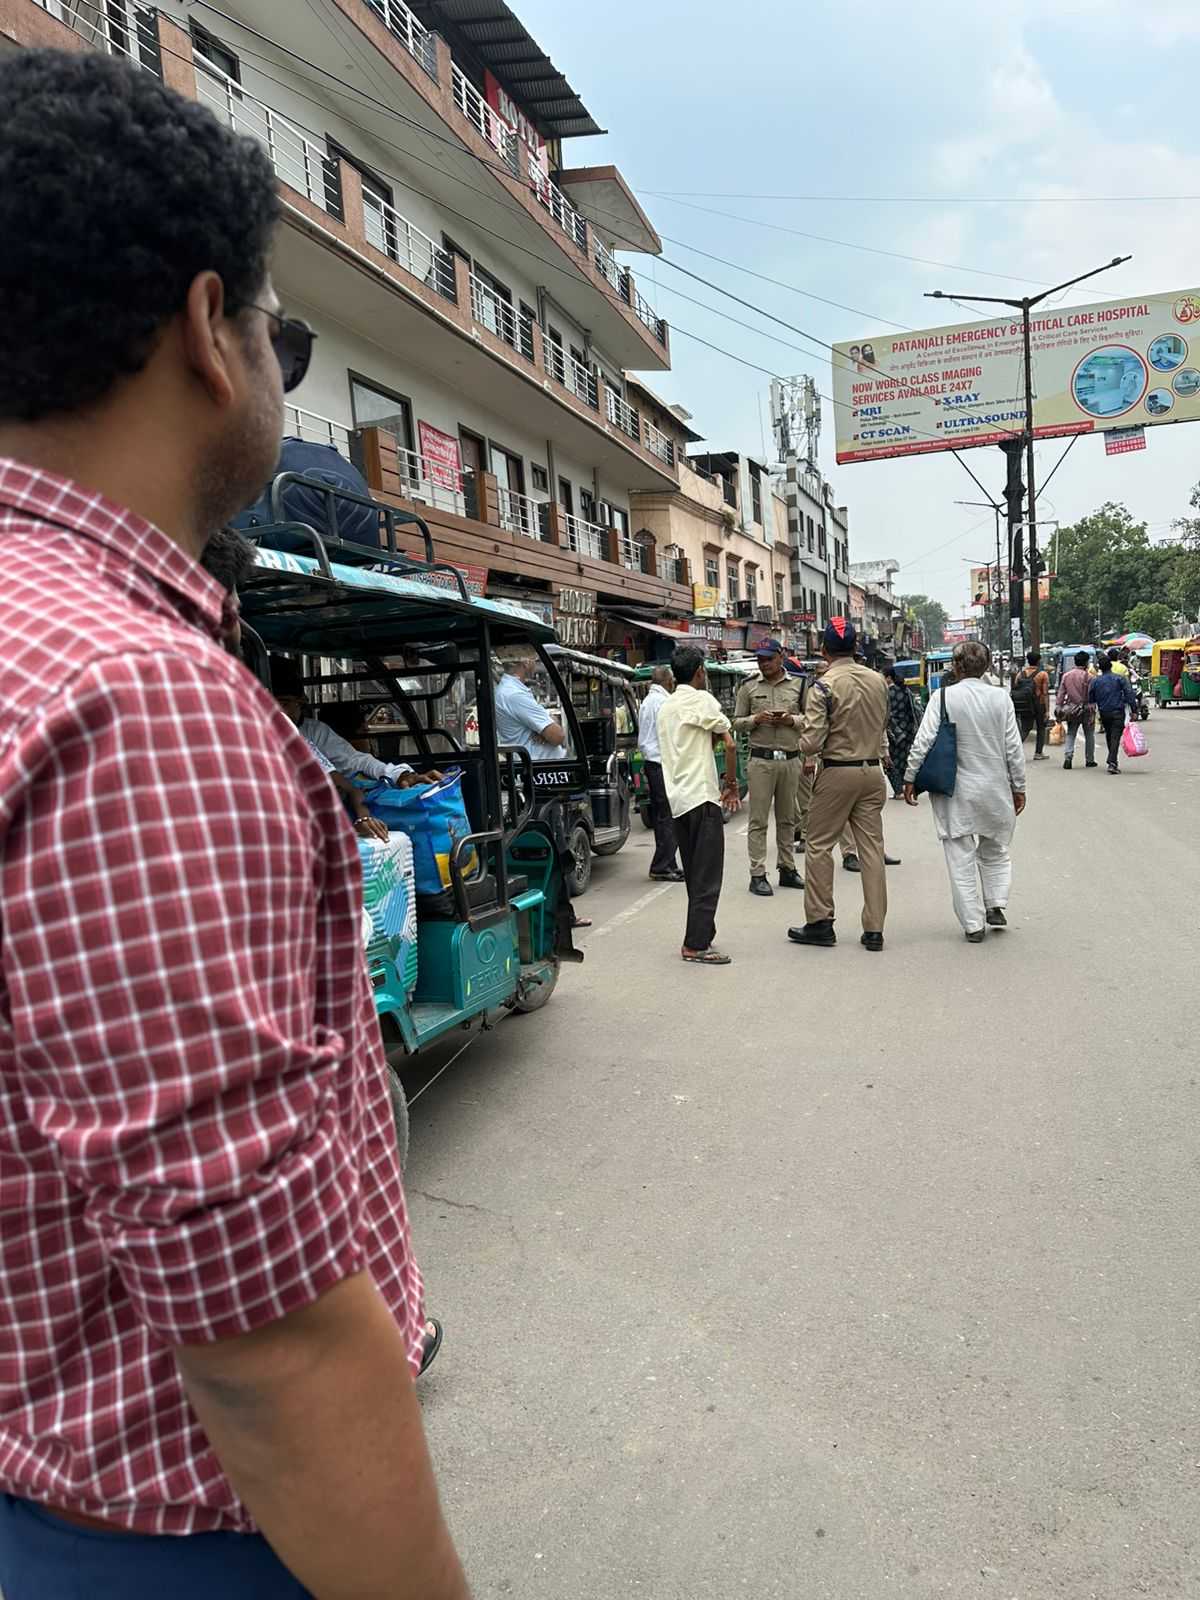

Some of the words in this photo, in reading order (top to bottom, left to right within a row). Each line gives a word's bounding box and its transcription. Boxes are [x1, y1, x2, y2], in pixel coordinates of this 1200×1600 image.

[497, 88, 541, 159] HOTEL
[892, 335, 944, 353] PATANJALI
[946, 326, 1008, 345] EMERGENCY
[1009, 324, 1017, 336] &
[1067, 312, 1095, 327] CARE
[1097, 304, 1150, 323] HOSPITAL
[852, 382, 874, 394] NOW
[875, 377, 908, 392] WORLD
[909, 373, 940, 387] CLASS
[942, 366, 982, 381] IMAGING
[852, 392, 896, 406] SERVICES
[897, 385, 946, 400] AVAILABLE
[949, 380, 974, 392] 24X7
[859, 406, 882, 417] MRI
[942, 392, 981, 406] X-RAY
[943, 410, 1028, 429] ULTRASOUND
[860, 429, 877, 441] CT
[878, 426, 911, 438] SCAN
[559, 588, 596, 615] HOTEL
